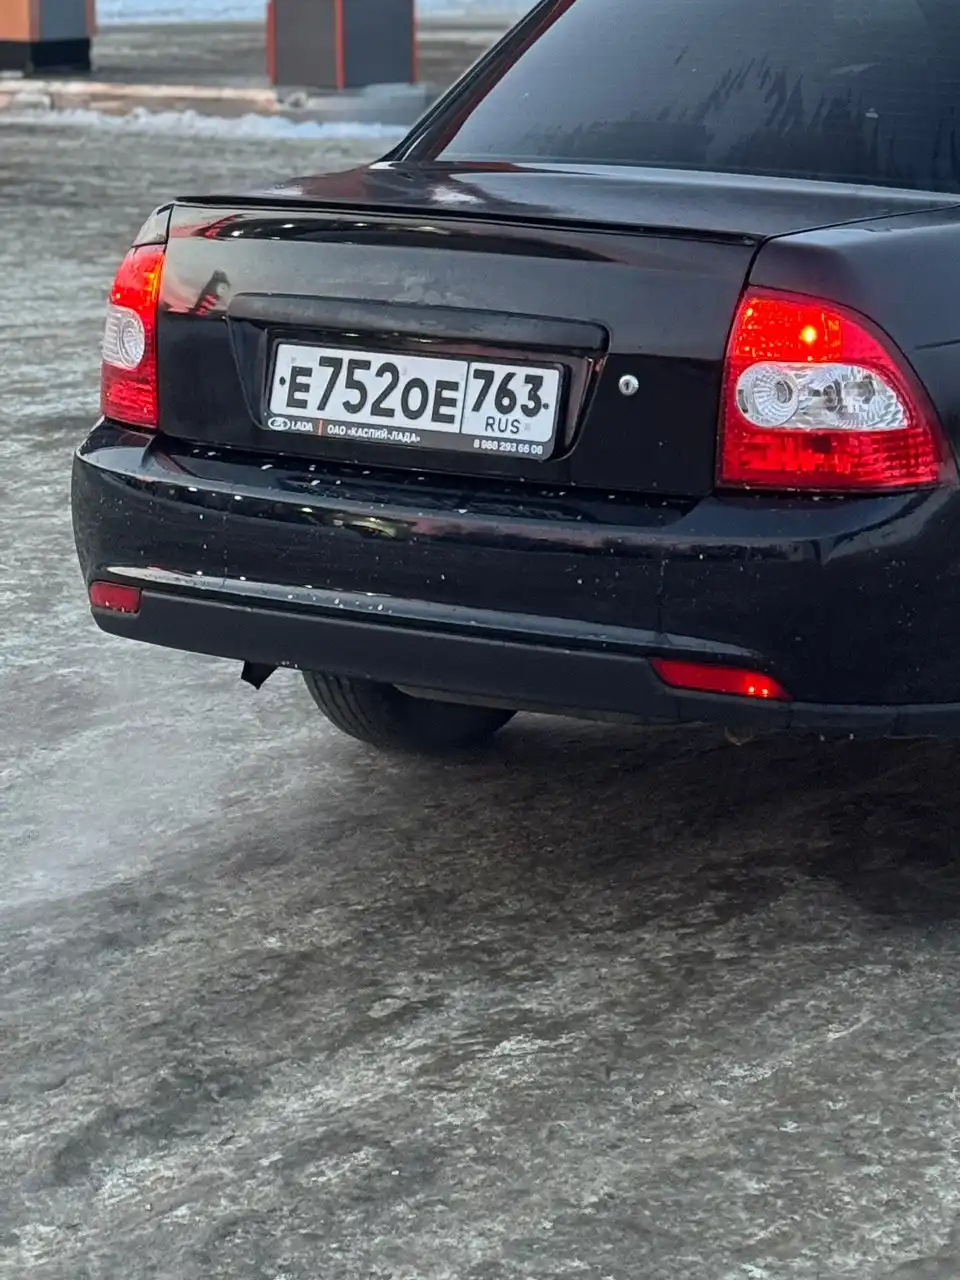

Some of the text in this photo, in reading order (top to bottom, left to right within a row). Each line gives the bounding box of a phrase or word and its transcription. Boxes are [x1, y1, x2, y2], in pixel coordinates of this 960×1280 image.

[471, 368, 544, 418] 763
[291, 419, 314, 432] LADA
[327, 424, 346, 435] ОАО
[485, 416, 521, 434] RUS
